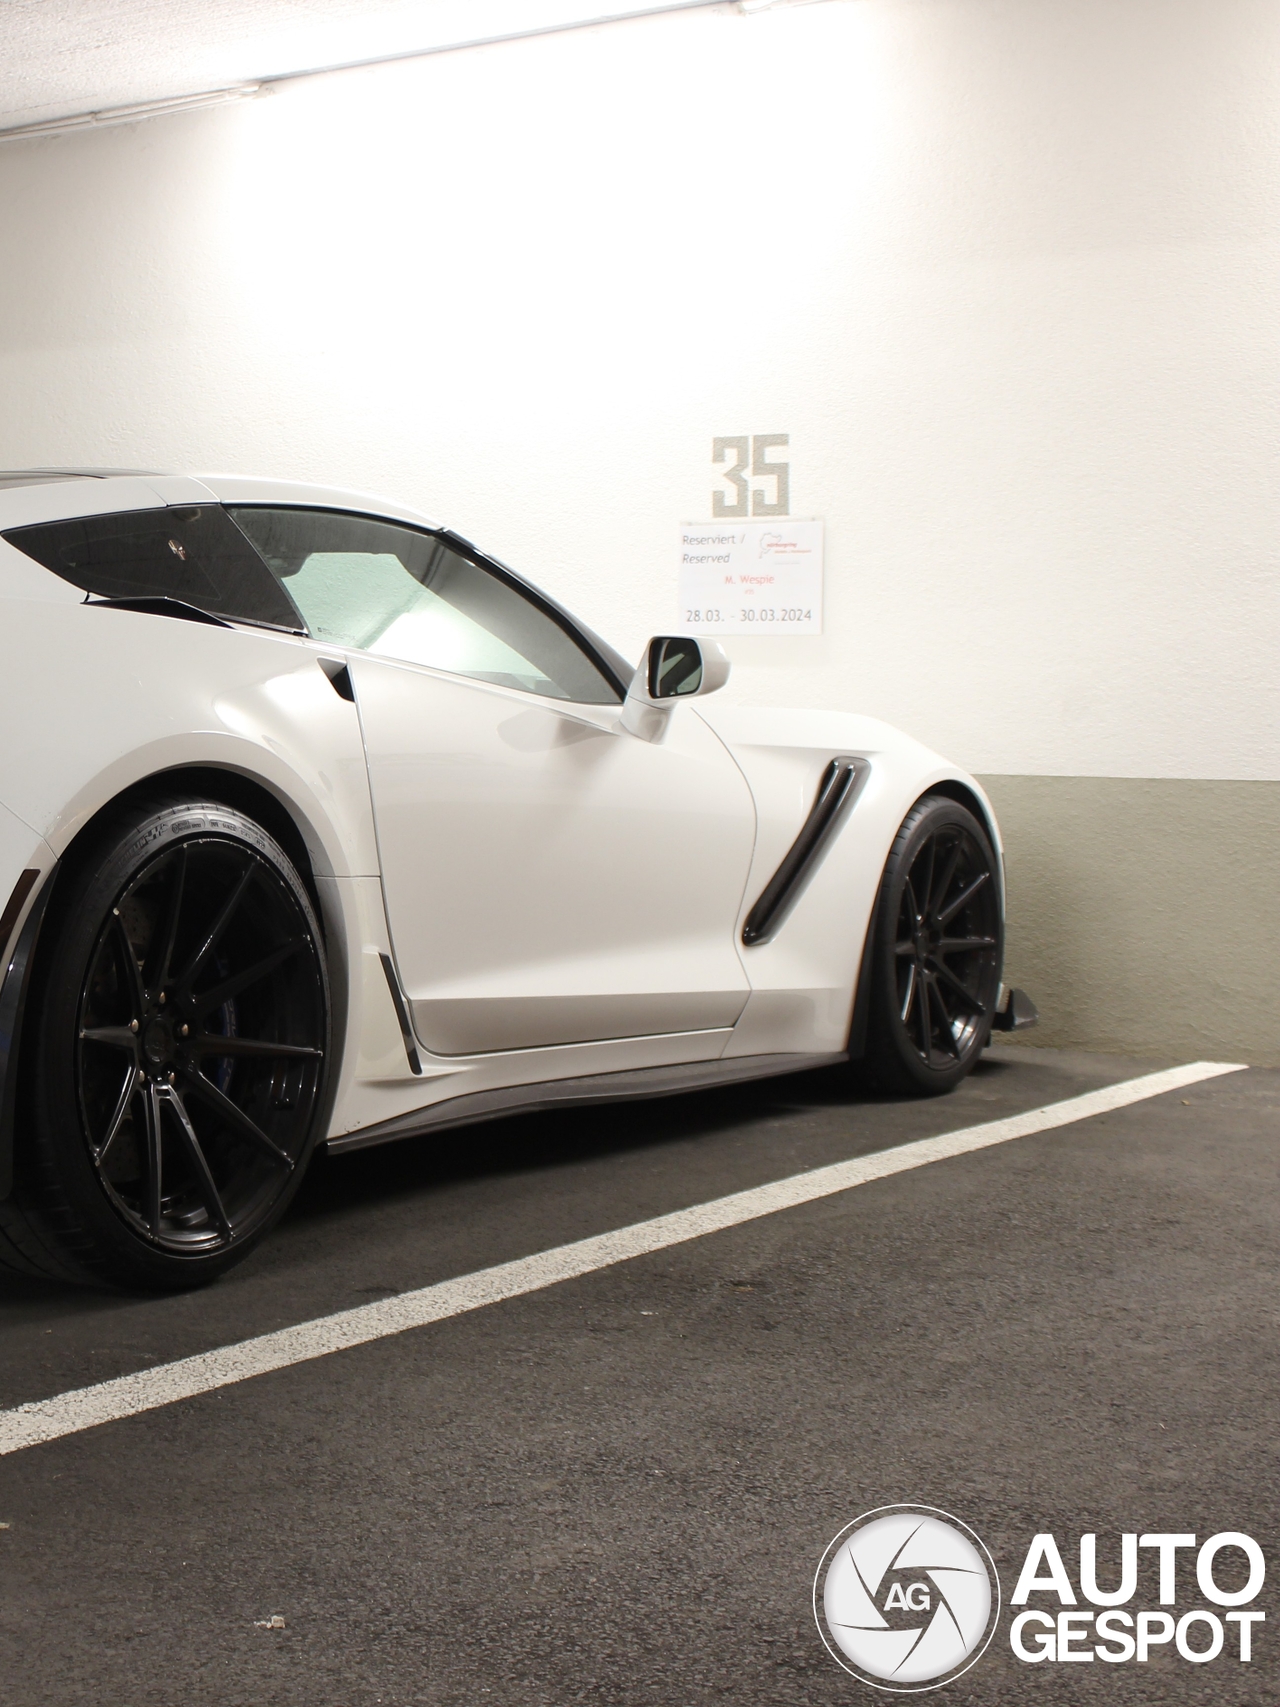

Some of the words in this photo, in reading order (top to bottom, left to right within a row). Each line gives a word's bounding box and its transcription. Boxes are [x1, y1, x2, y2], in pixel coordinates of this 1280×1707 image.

[712, 434, 790, 518] 35
[682, 535, 735, 545] Reserviert
[740, 534, 746, 544] /
[682, 553, 730, 564] Reserved
[725, 575, 736, 584] M.
[740, 575, 775, 586] Wespie
[686, 610, 725, 622] 28.03.
[740, 609, 812, 622] 30.03.2024
